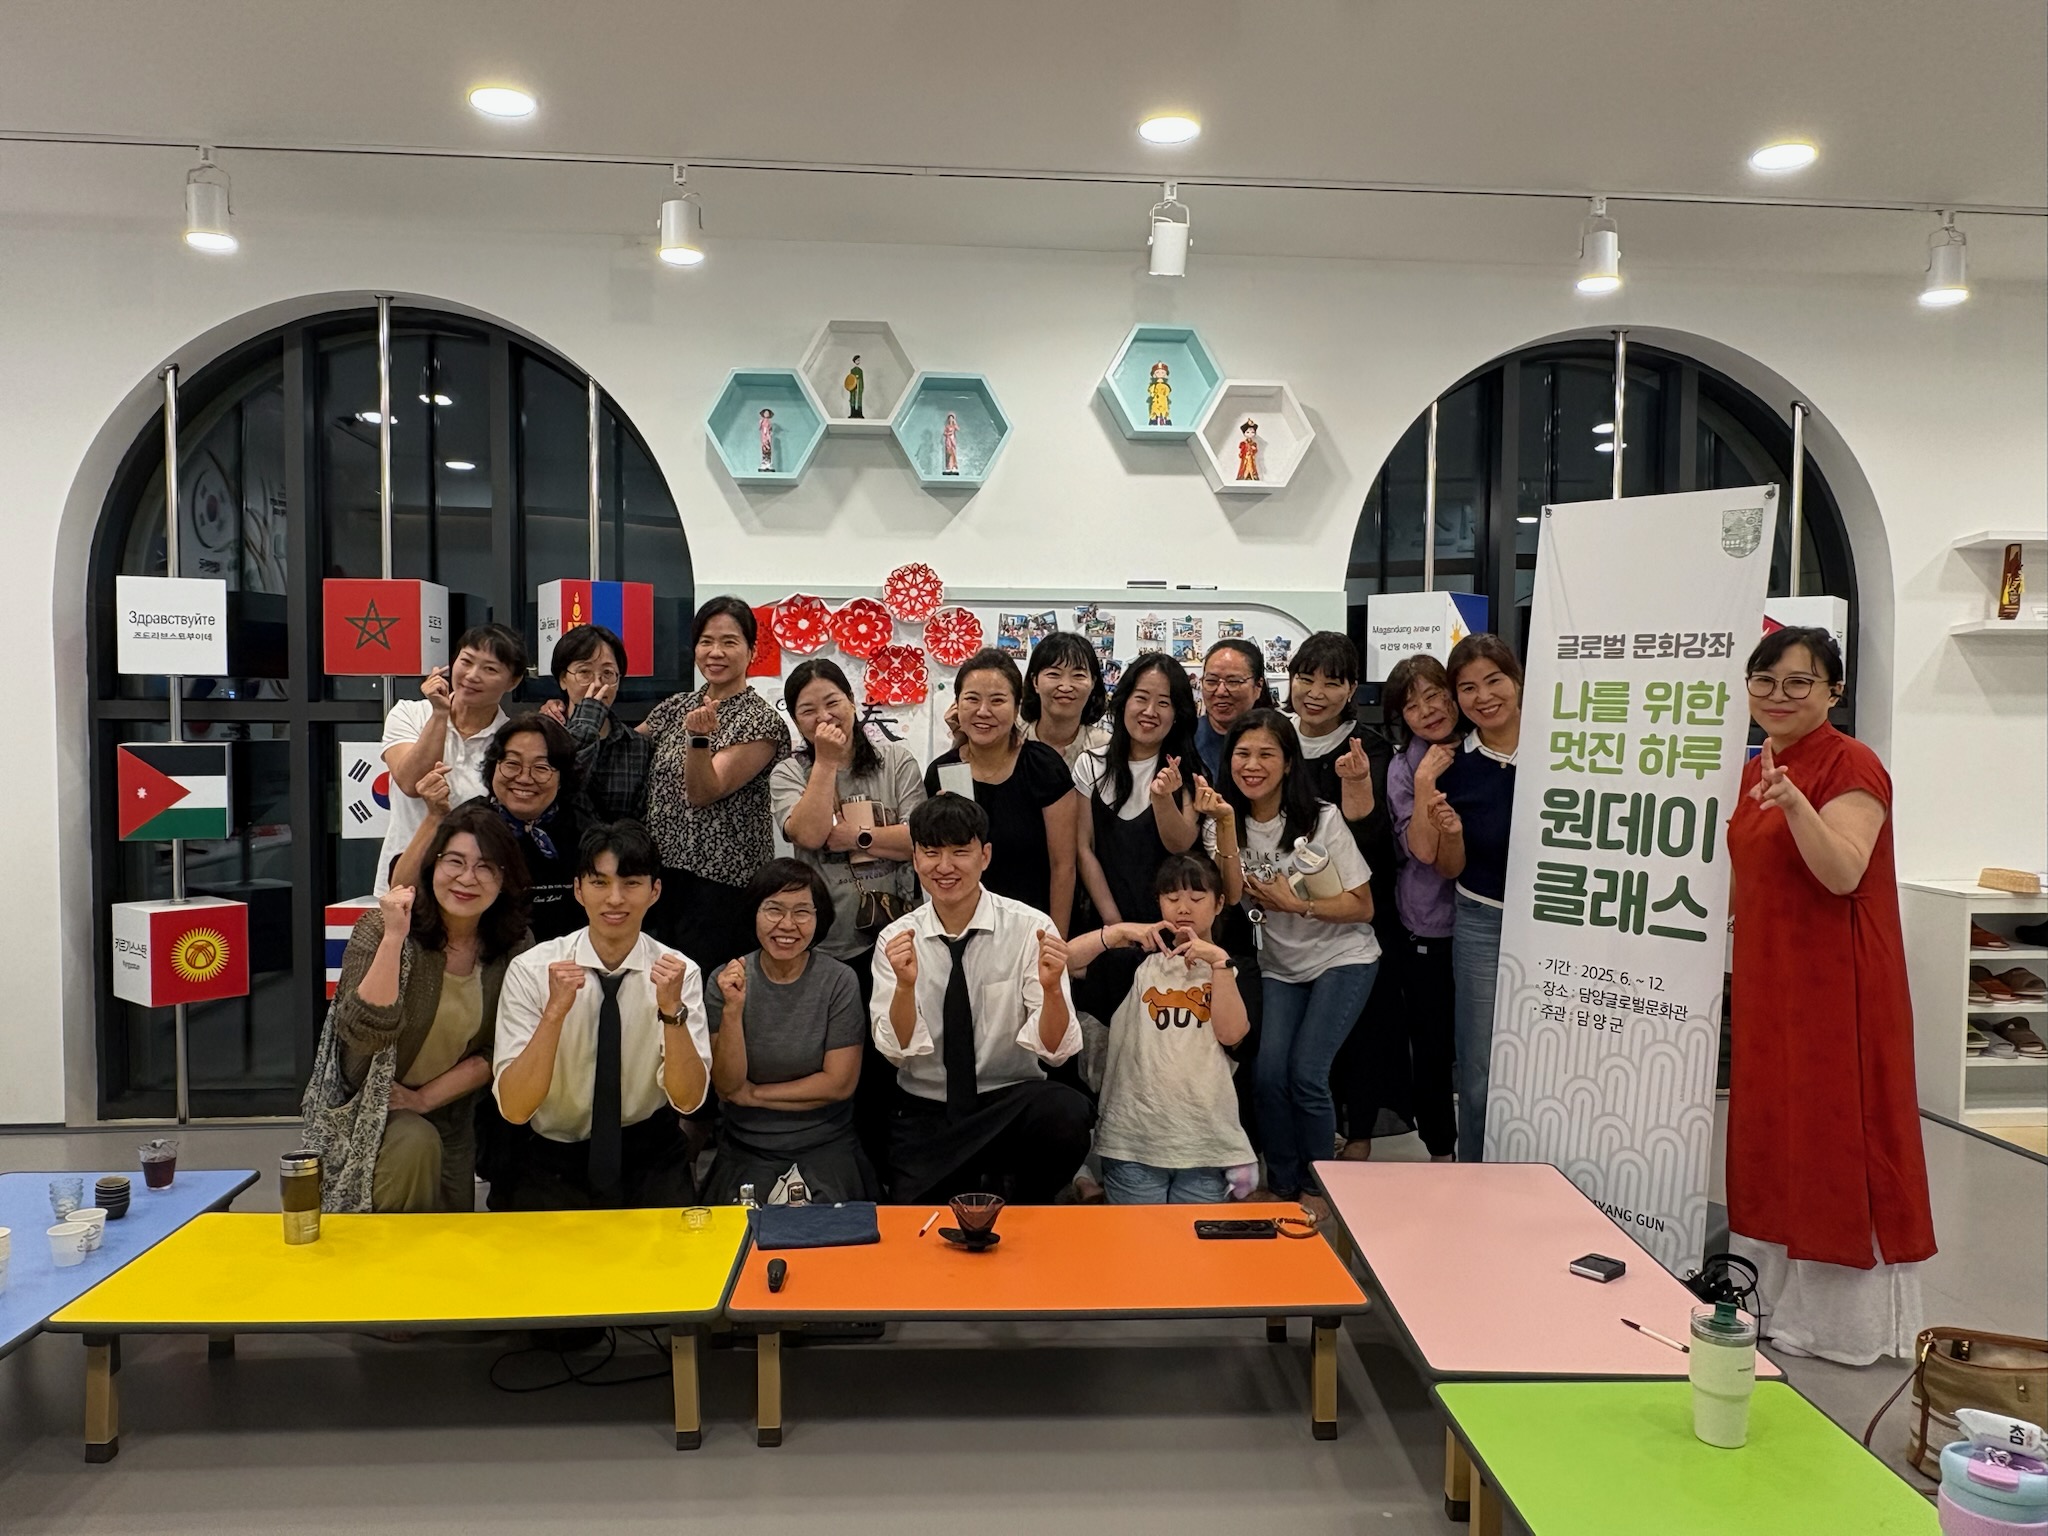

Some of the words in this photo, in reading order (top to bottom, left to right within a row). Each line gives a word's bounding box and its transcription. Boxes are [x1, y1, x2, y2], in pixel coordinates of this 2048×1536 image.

[128, 610, 216, 629] Здравствуйте
[1557, 634, 1626, 660] 글로벌
[1633, 632, 1735, 659] 문화강좌
[1552, 680, 1630, 724] 나를
[1643, 680, 1731, 726] 위한
[1549, 731, 1626, 775] 멋진
[1638, 733, 1723, 781] 하루
[1539, 788, 1719, 864] 원데이
[1245, 850, 1281, 862] NIKE
[1533, 861, 1708, 943] 클래스
[1544, 958, 1572, 977] 기간
[1581, 964, 1616, 984] 2025.
[1620, 971, 1632, 986] 6.
[1540, 1003, 1567, 1023] 주관
[1542, 980, 1569, 999] 장소
[1579, 987, 1688, 1023] 담양글로벌문화관
[1155, 1007, 1202, 1031] OU
[1636, 1213, 1665, 1233] GUN
